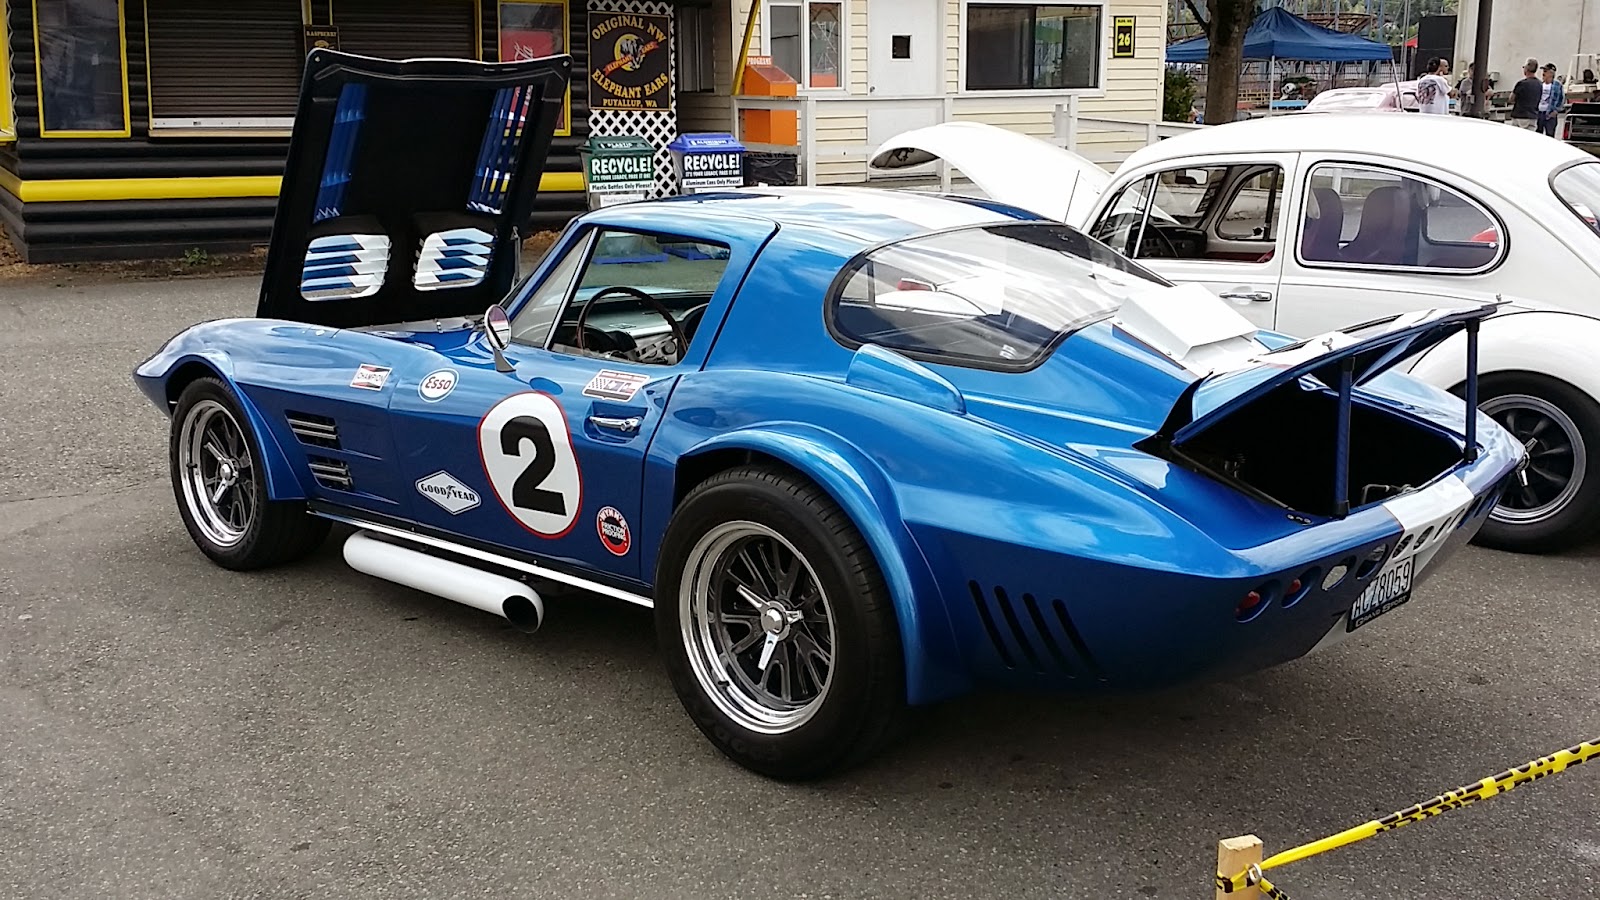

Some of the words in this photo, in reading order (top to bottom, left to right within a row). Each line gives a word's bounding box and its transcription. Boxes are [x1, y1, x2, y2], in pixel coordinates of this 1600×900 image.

[592, 15, 644, 39] ORIGINAL
[647, 23, 667, 42] NW
[1118, 33, 1130, 46] 26
[607, 55, 632, 71] ELEPHANT
[641, 43, 655, 54] EARS
[592, 69, 642, 98] ELEPHANT
[644, 72, 668, 96] EARS
[603, 98, 643, 107] PUYALLUP,
[591, 156, 652, 174] RECYCLE!
[684, 153, 740, 171] RECYCLE!
[500, 415, 567, 516] 2
[600, 509, 626, 528] WYNN'S
[602, 521, 626, 536] FRICTION
[602, 529, 627, 541] PROOFING
[1356, 609, 1381, 627] GRAND
[1382, 595, 1407, 613] SPORT
